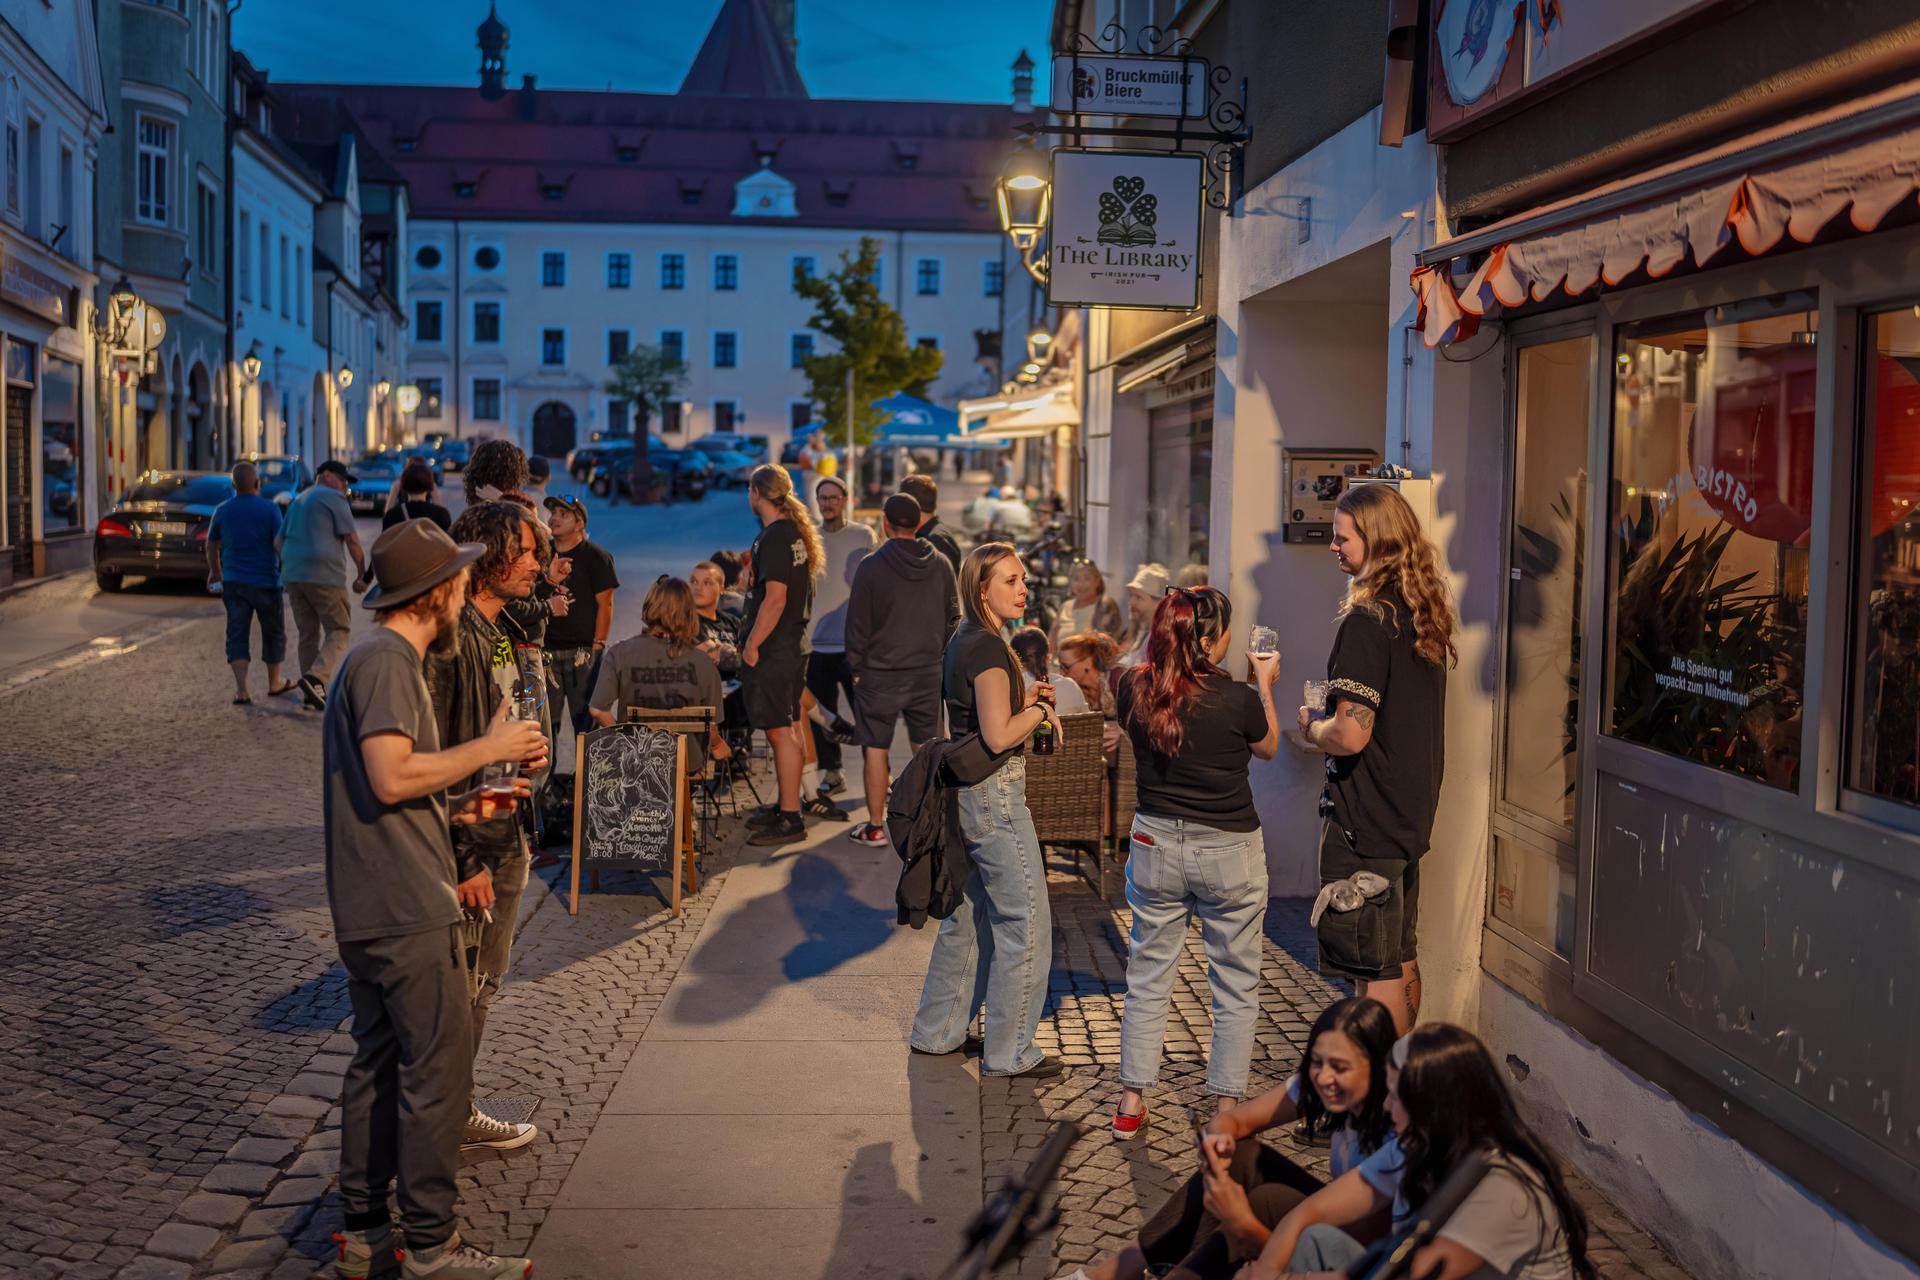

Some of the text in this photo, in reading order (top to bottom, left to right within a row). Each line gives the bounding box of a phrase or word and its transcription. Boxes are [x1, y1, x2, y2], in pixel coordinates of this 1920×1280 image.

[1105, 83, 1142, 98] Biere
[1697, 463, 1758, 523] BISTRO
[1671, 655, 1733, 685] Alle Speisen gut
[1655, 673, 1749, 707] verpackt zum Mitnehmen
